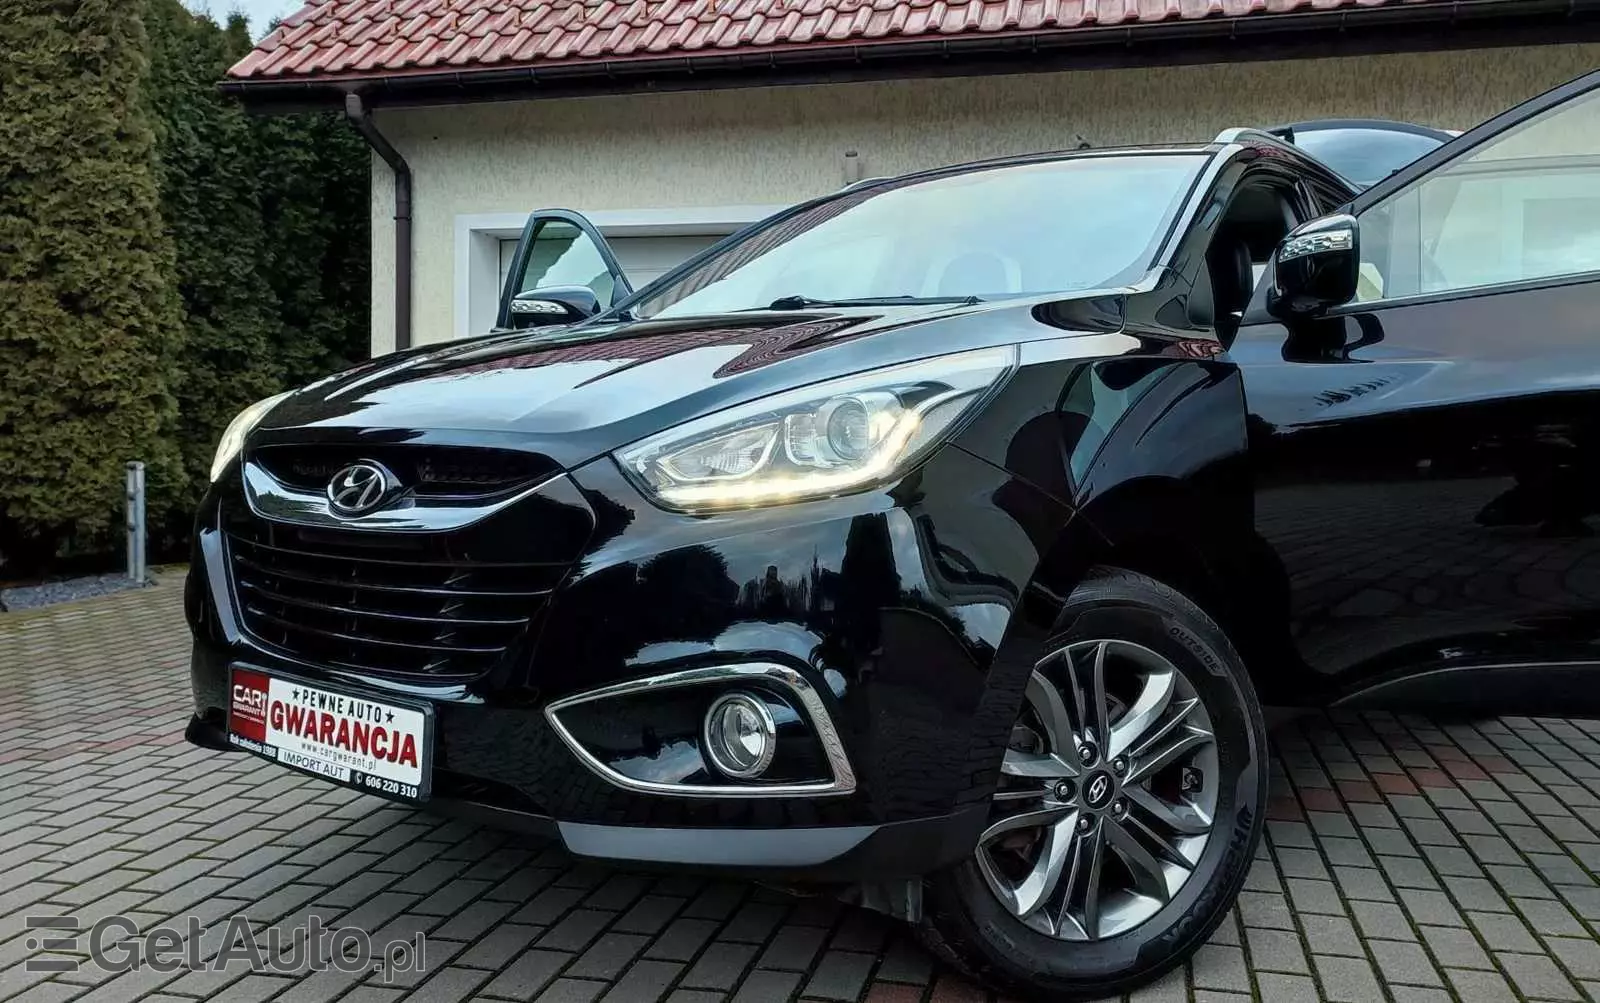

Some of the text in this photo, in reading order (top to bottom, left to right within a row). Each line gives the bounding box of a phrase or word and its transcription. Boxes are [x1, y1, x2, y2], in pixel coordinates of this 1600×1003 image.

[1169, 627, 1219, 672] OUTSIDE
[302, 689, 382, 724] PEWNE AUTO
[270, 699, 418, 768] GWARANCJA
[283, 751, 345, 779] IMPORT AUT
[365, 775, 417, 798] 606 220 310
